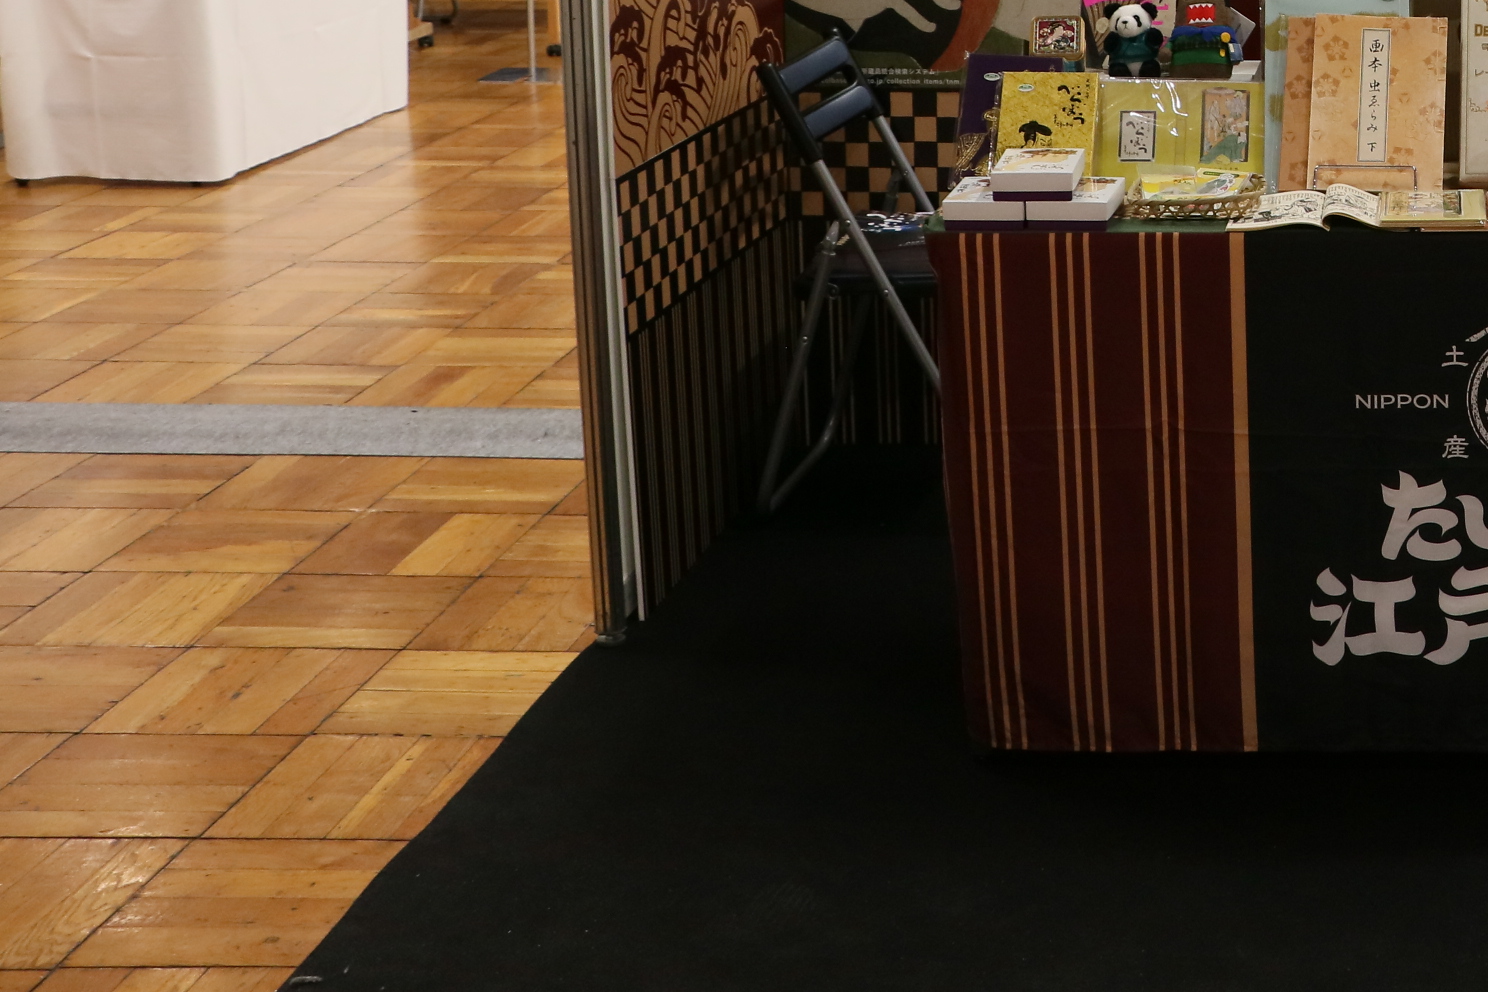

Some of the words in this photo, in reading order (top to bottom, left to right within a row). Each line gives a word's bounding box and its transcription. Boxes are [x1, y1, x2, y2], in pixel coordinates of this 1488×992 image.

[1441, 345, 1469, 368] 土
[1355, 393, 1449, 410] NIPPON
[1441, 434, 1470, 460] 産
